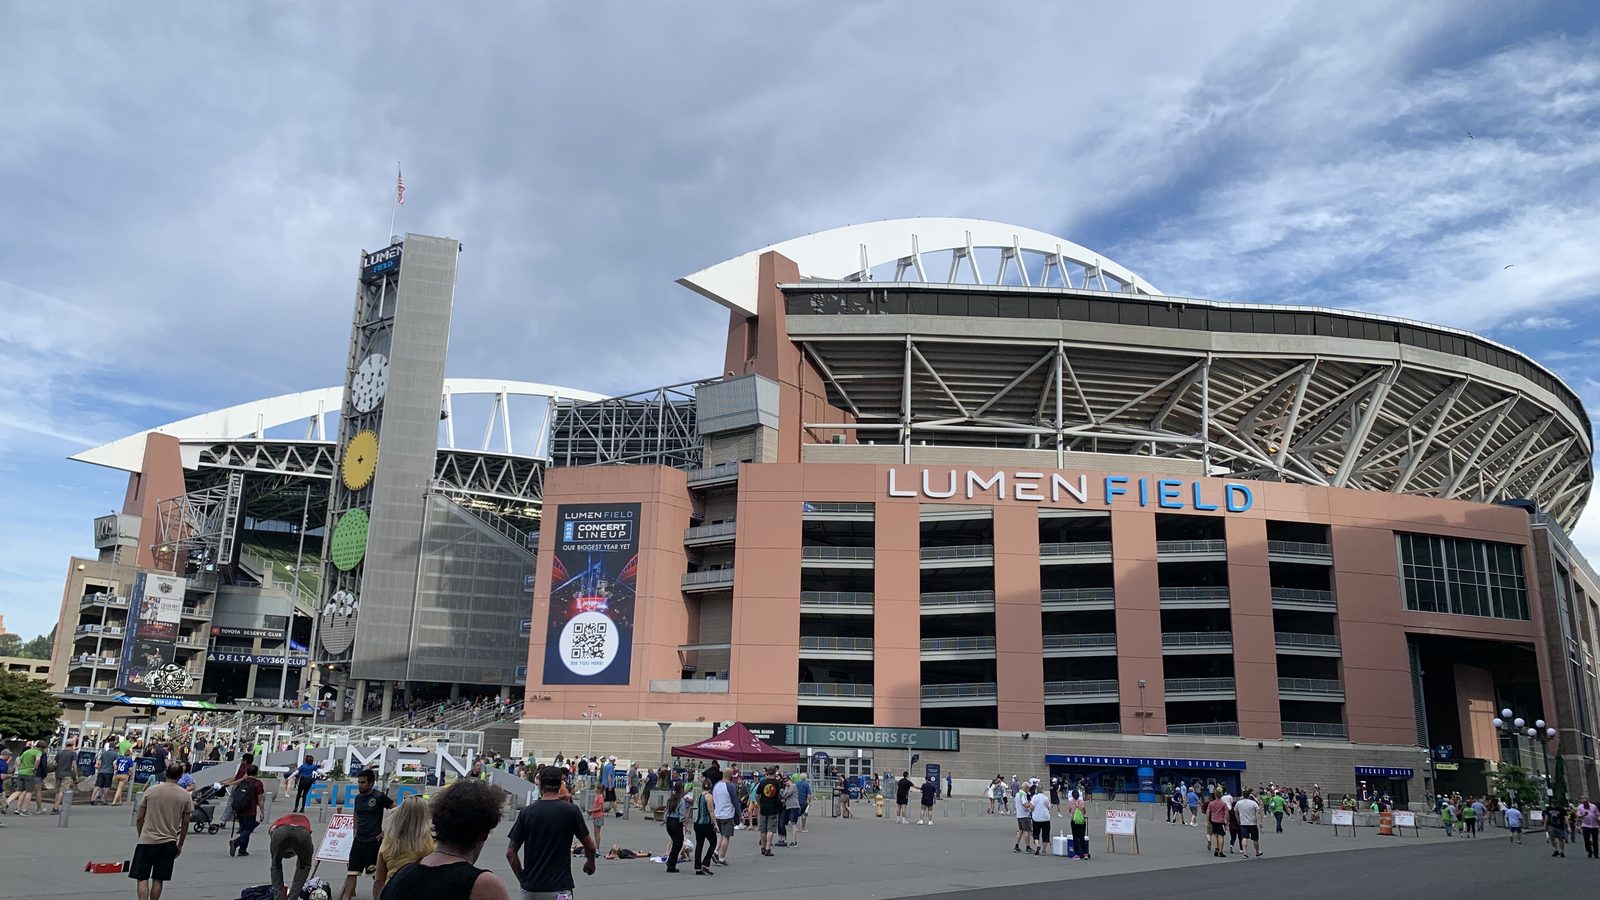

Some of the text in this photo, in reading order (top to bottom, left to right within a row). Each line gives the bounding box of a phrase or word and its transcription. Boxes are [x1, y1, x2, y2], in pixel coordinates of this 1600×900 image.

[363, 246, 403, 268] LUMEN
[889, 468, 1254, 512] LUMEN FIELD
[578, 523, 627, 531] CONCERT
[577, 531, 626, 539] LINEUP
[218, 653, 306, 666] DELTA SKY360 CLUB
[829, 730, 917, 744] SOUNDERS FC
[260, 741, 474, 778] LUMEN
[1066, 757, 1227, 768] NORTHWEST TICKET OFFICE
[118, 763, 126, 771] 16
[330, 816, 343, 829] NO
